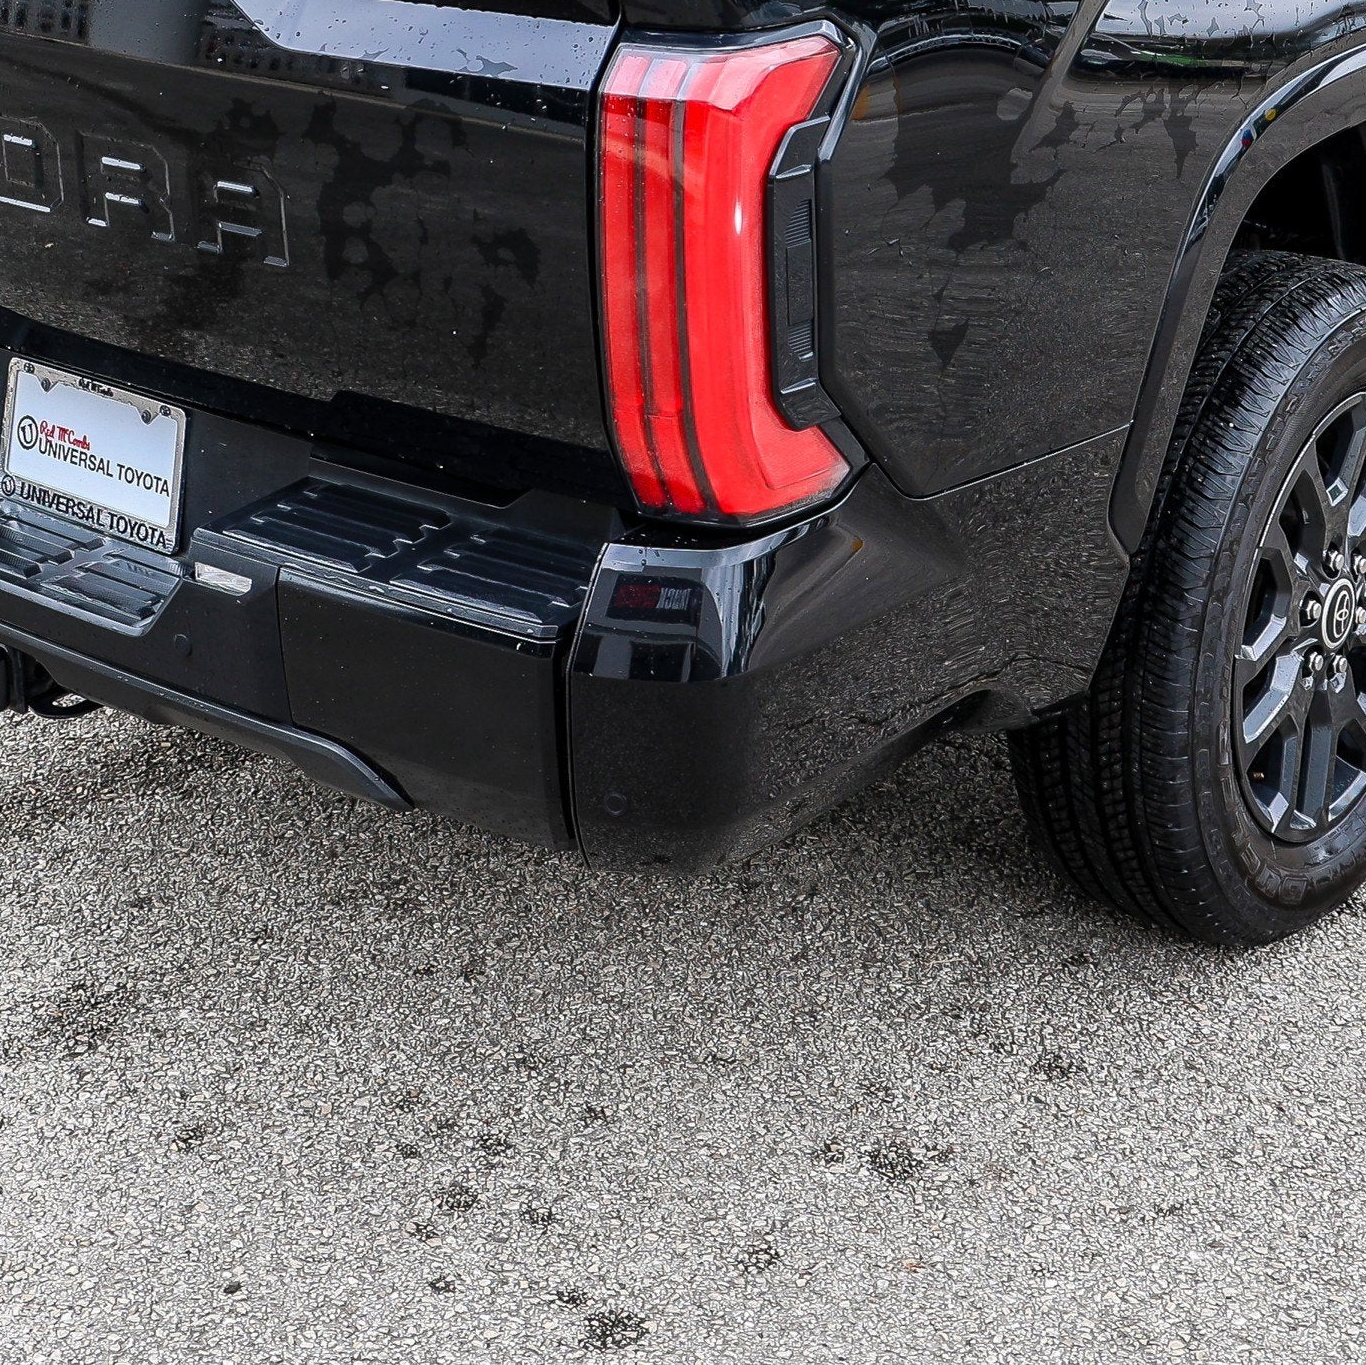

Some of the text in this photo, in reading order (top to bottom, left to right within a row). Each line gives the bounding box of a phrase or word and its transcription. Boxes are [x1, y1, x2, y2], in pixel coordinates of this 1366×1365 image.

[39, 420, 56, 438] Red
[39, 436, 170, 497] UNIVERSAL TOYOTA
[20, 482, 105, 527] UNIVERSAL
[106, 513, 168, 550] TOYOTA
